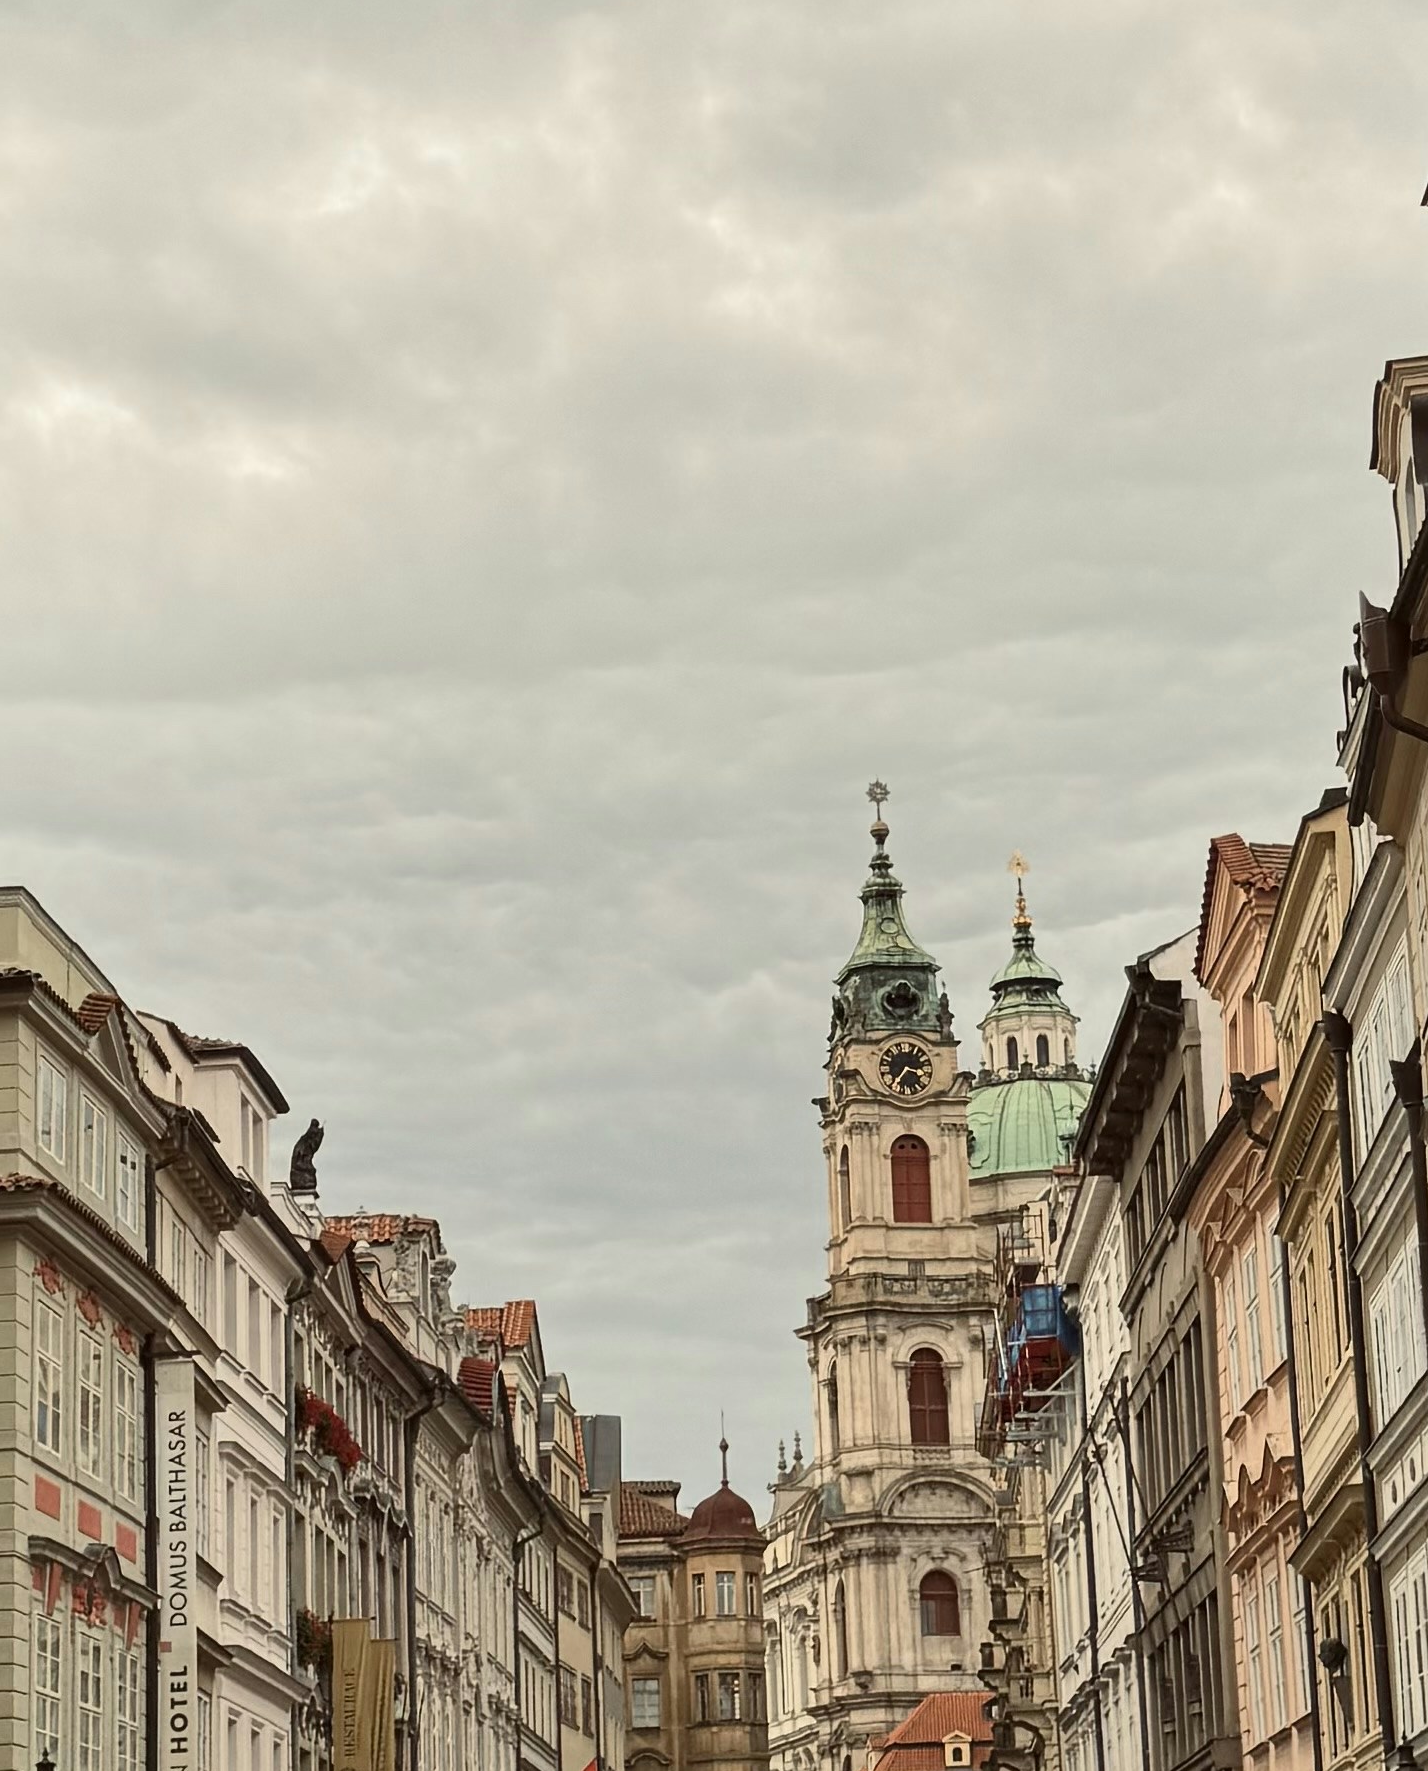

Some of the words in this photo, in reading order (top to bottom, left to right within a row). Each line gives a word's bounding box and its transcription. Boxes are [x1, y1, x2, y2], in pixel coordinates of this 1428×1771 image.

[169, 1410, 186, 1532] BALTHASAR
[169, 1540, 187, 1627] DOMUS
[170, 1665, 188, 1754] HOTEL
